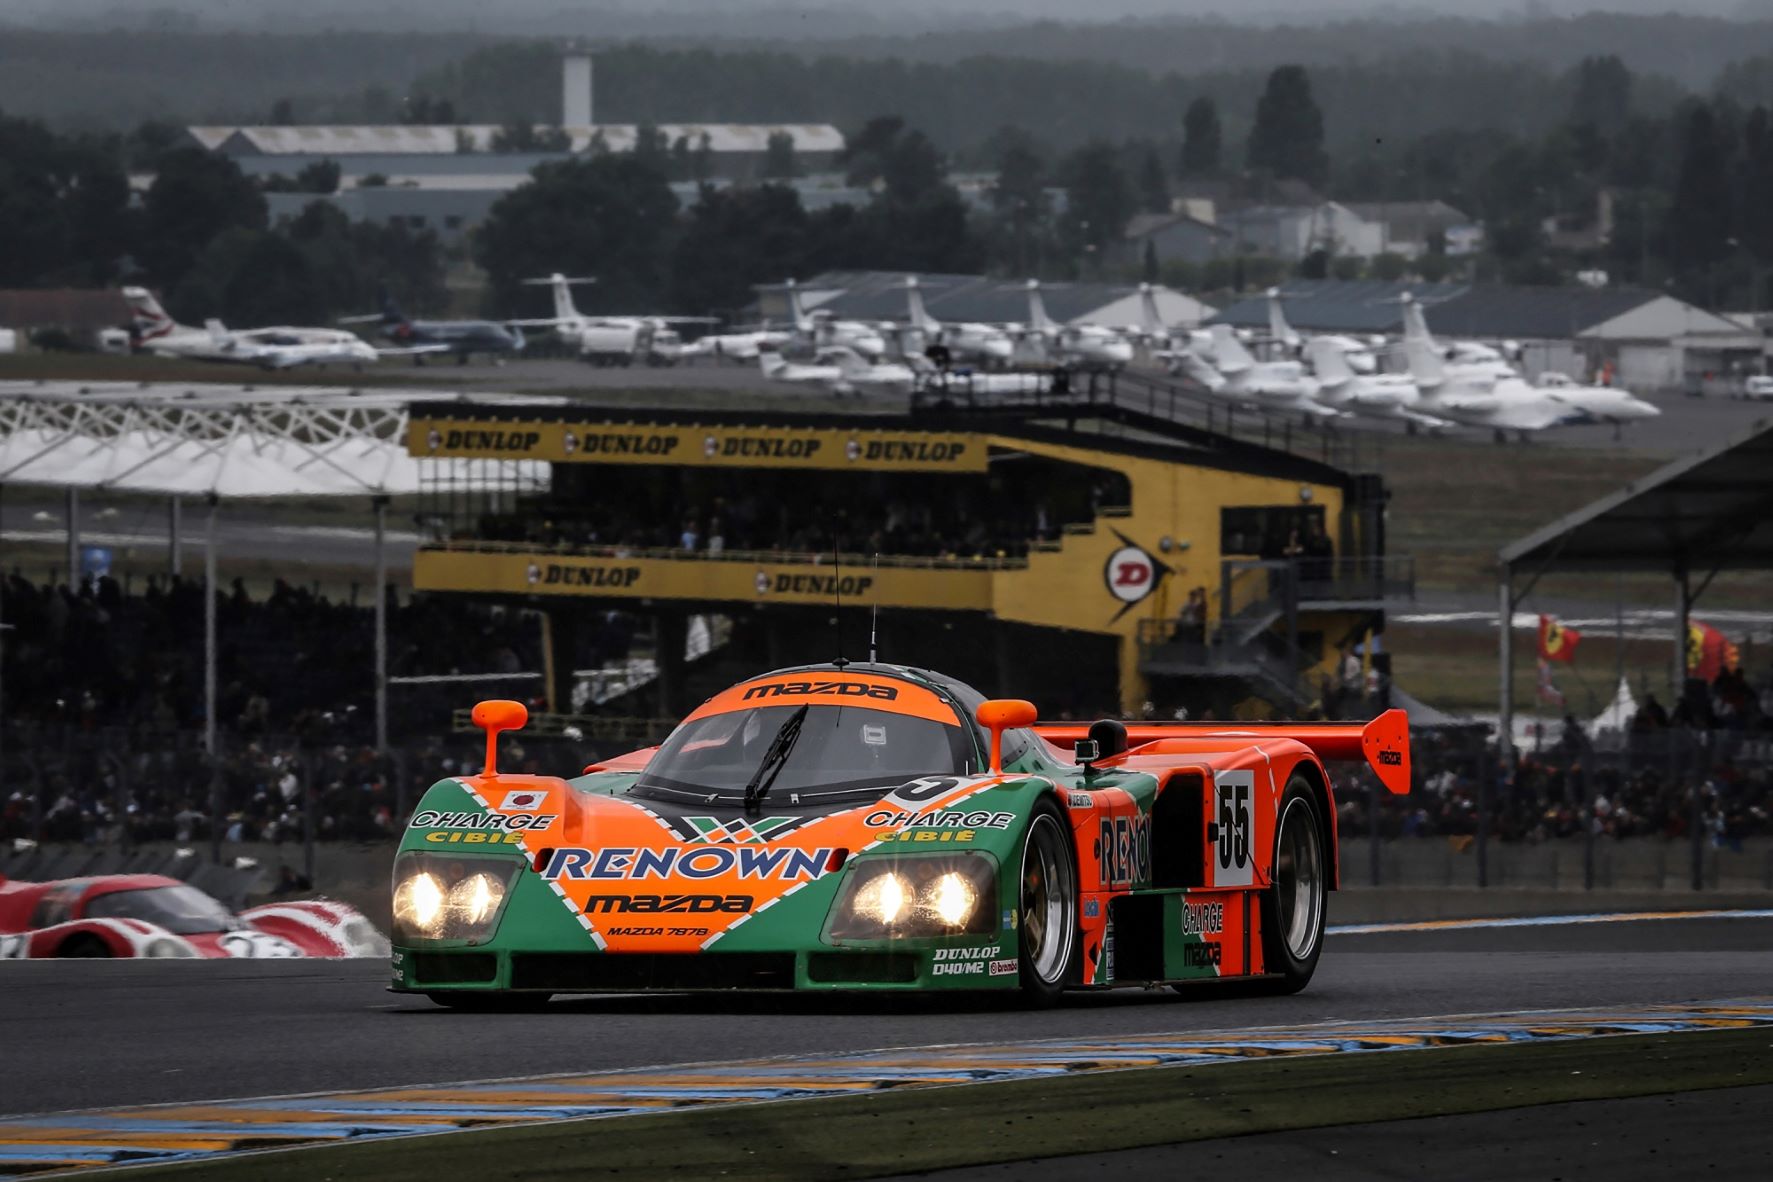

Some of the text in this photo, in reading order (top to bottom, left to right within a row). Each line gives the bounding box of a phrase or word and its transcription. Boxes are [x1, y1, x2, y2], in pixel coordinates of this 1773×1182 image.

[445, 430, 965, 461] DUNLOP DUNLOP DUNLOP DUNLOP
[544, 564, 873, 596] DUNLOP DUNLOP
[742, 682, 898, 701] mazda
[409, 810, 559, 830] CHARGE
[864, 811, 1016, 830] CHARGE
[1219, 785, 1249, 869] 55
[541, 847, 834, 880] RENOWN
[584, 895, 754, 913] mazda
[1182, 901, 1223, 936] CHARGE
[606, 927, 709, 936] MAZDA 787B
[932, 946, 1001, 961] DUNLOP
[932, 962, 985, 976] D40/M2
